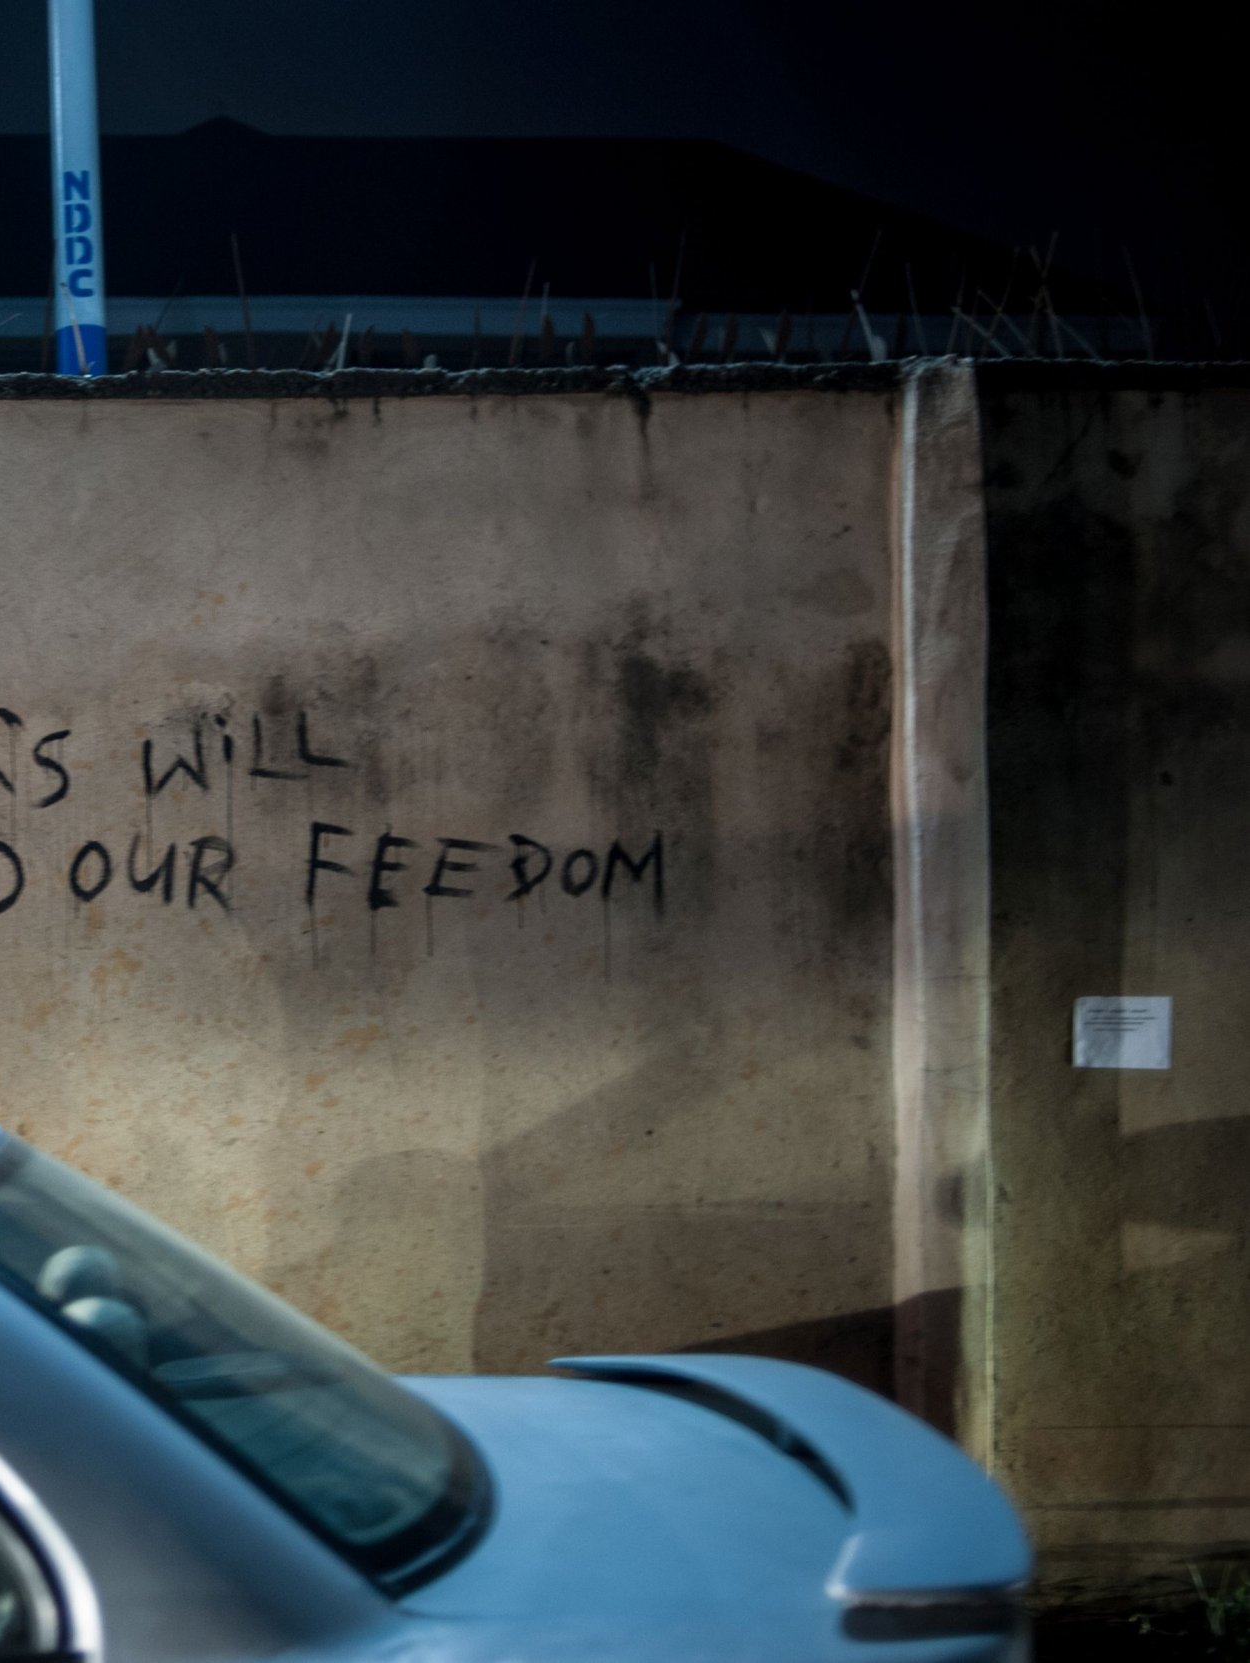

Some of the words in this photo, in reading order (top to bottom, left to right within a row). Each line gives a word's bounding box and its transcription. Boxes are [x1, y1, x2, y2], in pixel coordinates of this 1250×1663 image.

[62, 169, 95, 298] NDDC
[141, 711, 352, 795] WiLL
[68, 832, 234, 912] OUR
[306, 821, 668, 916] FEEDOM
